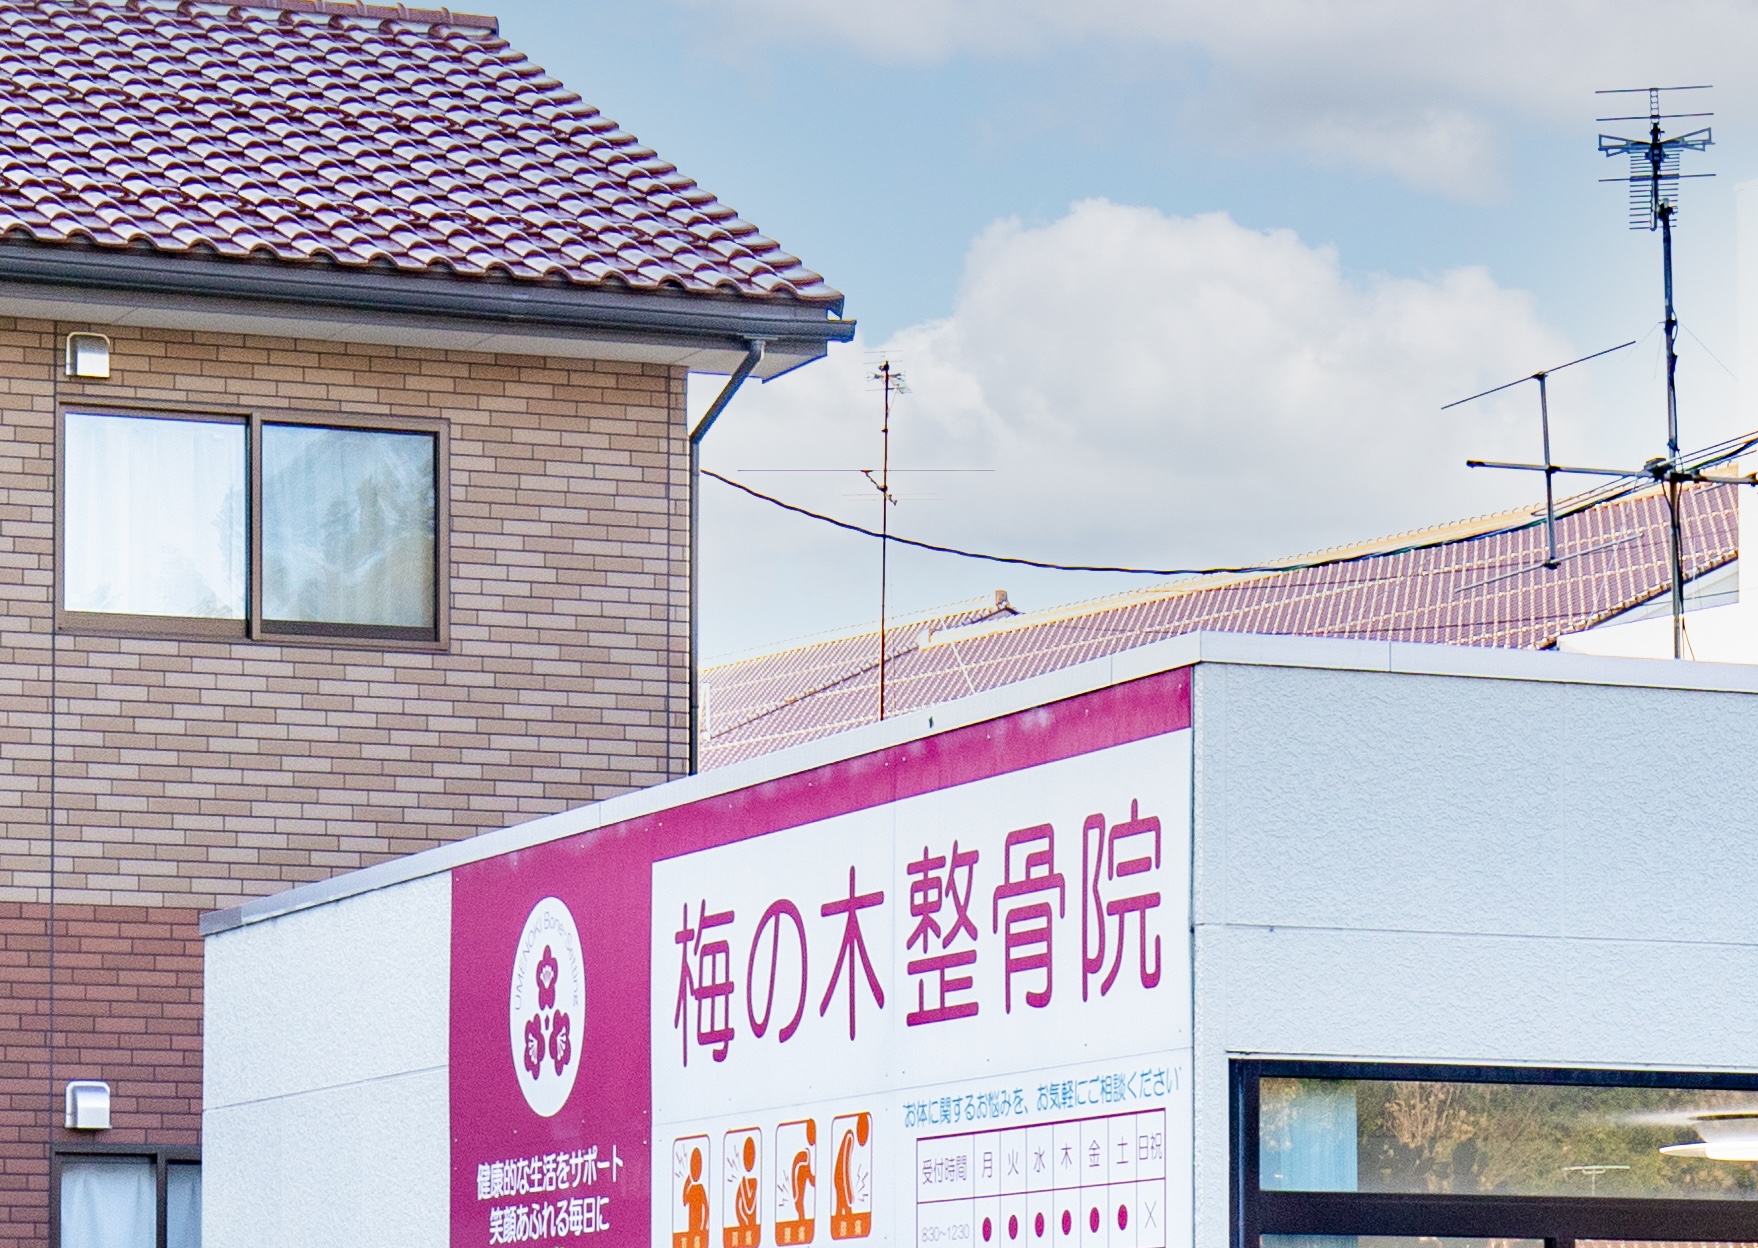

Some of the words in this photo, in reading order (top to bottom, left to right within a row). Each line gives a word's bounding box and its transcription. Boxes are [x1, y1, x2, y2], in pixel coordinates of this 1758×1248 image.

[674, 799, 1163, 1068] 梅の木整骨院
[476, 1144, 624, 1201] 健康的な生活をサポート
[922, 1154, 968, 1185] 受付時間
[981, 1151, 993, 1179] 月
[1007, 1149, 1019, 1176] 火
[1033, 1146, 1046, 1173] 水
[1060, 1142, 1073, 1170] 木
[1088, 1139, 1101, 1168] 金
[1116, 1136, 1129, 1164] 土
[489, 1195, 610, 1245] 笑顔あふれる毎日に
